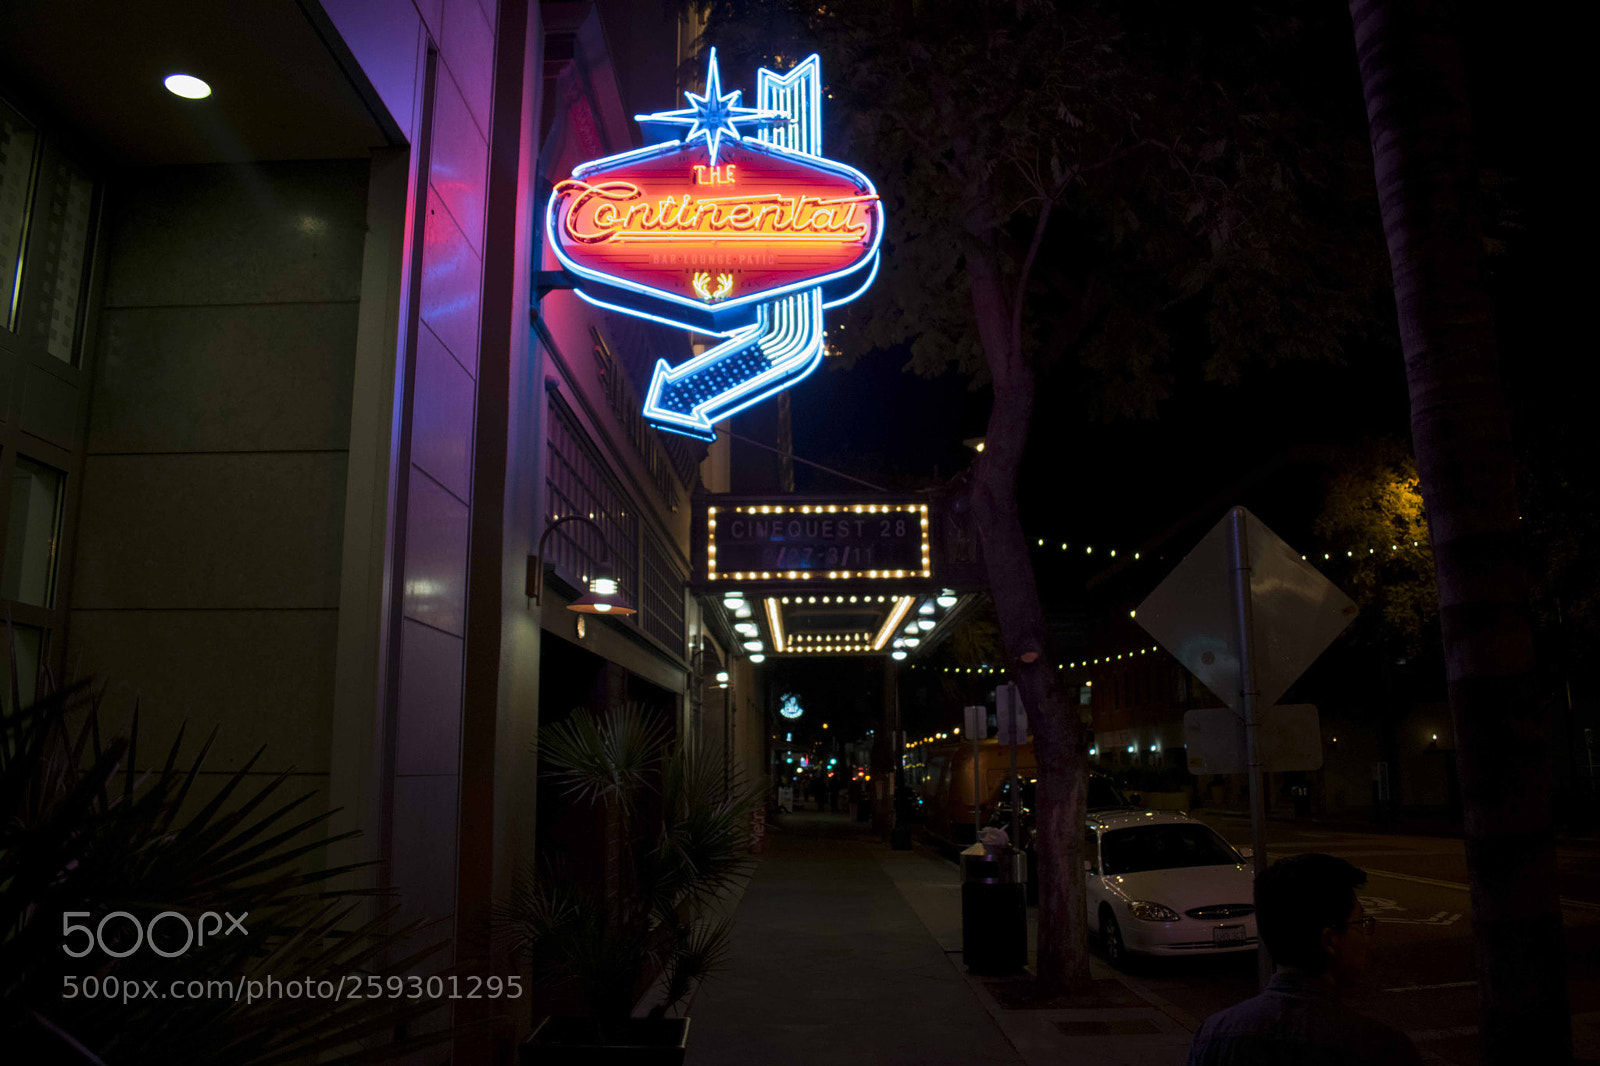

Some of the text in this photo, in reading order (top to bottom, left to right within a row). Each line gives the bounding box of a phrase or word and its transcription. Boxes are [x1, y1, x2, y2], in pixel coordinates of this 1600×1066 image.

[692, 164, 736, 185] THE
[552, 179, 880, 243] Continental
[652, 254, 775, 266] BAR LOUNGE PATIO
[731, 519, 907, 538] CINEQUEST 28
